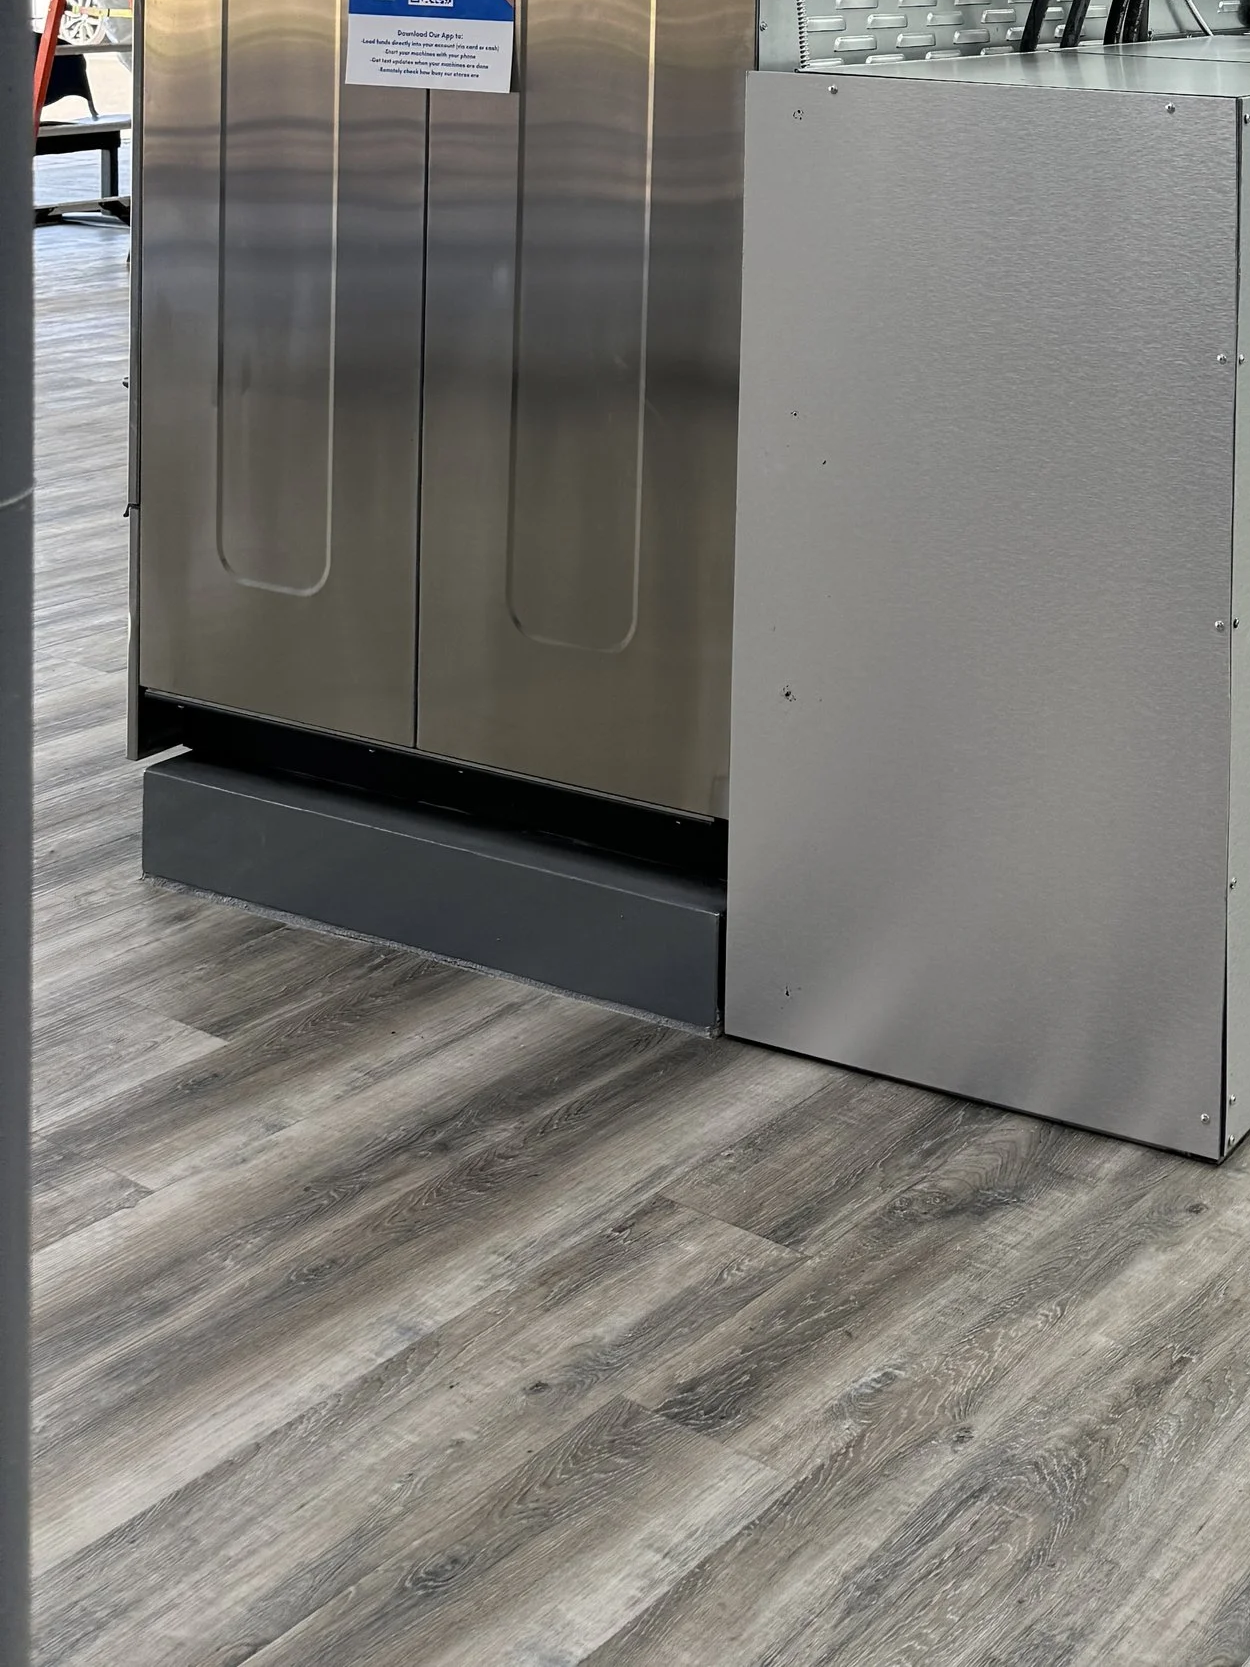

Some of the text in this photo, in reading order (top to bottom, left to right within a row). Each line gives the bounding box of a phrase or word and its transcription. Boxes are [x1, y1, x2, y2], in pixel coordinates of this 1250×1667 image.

[397, 30, 428, 38] Download
[429, 31, 440, 39] Our
[441, 32, 454, 41] App
